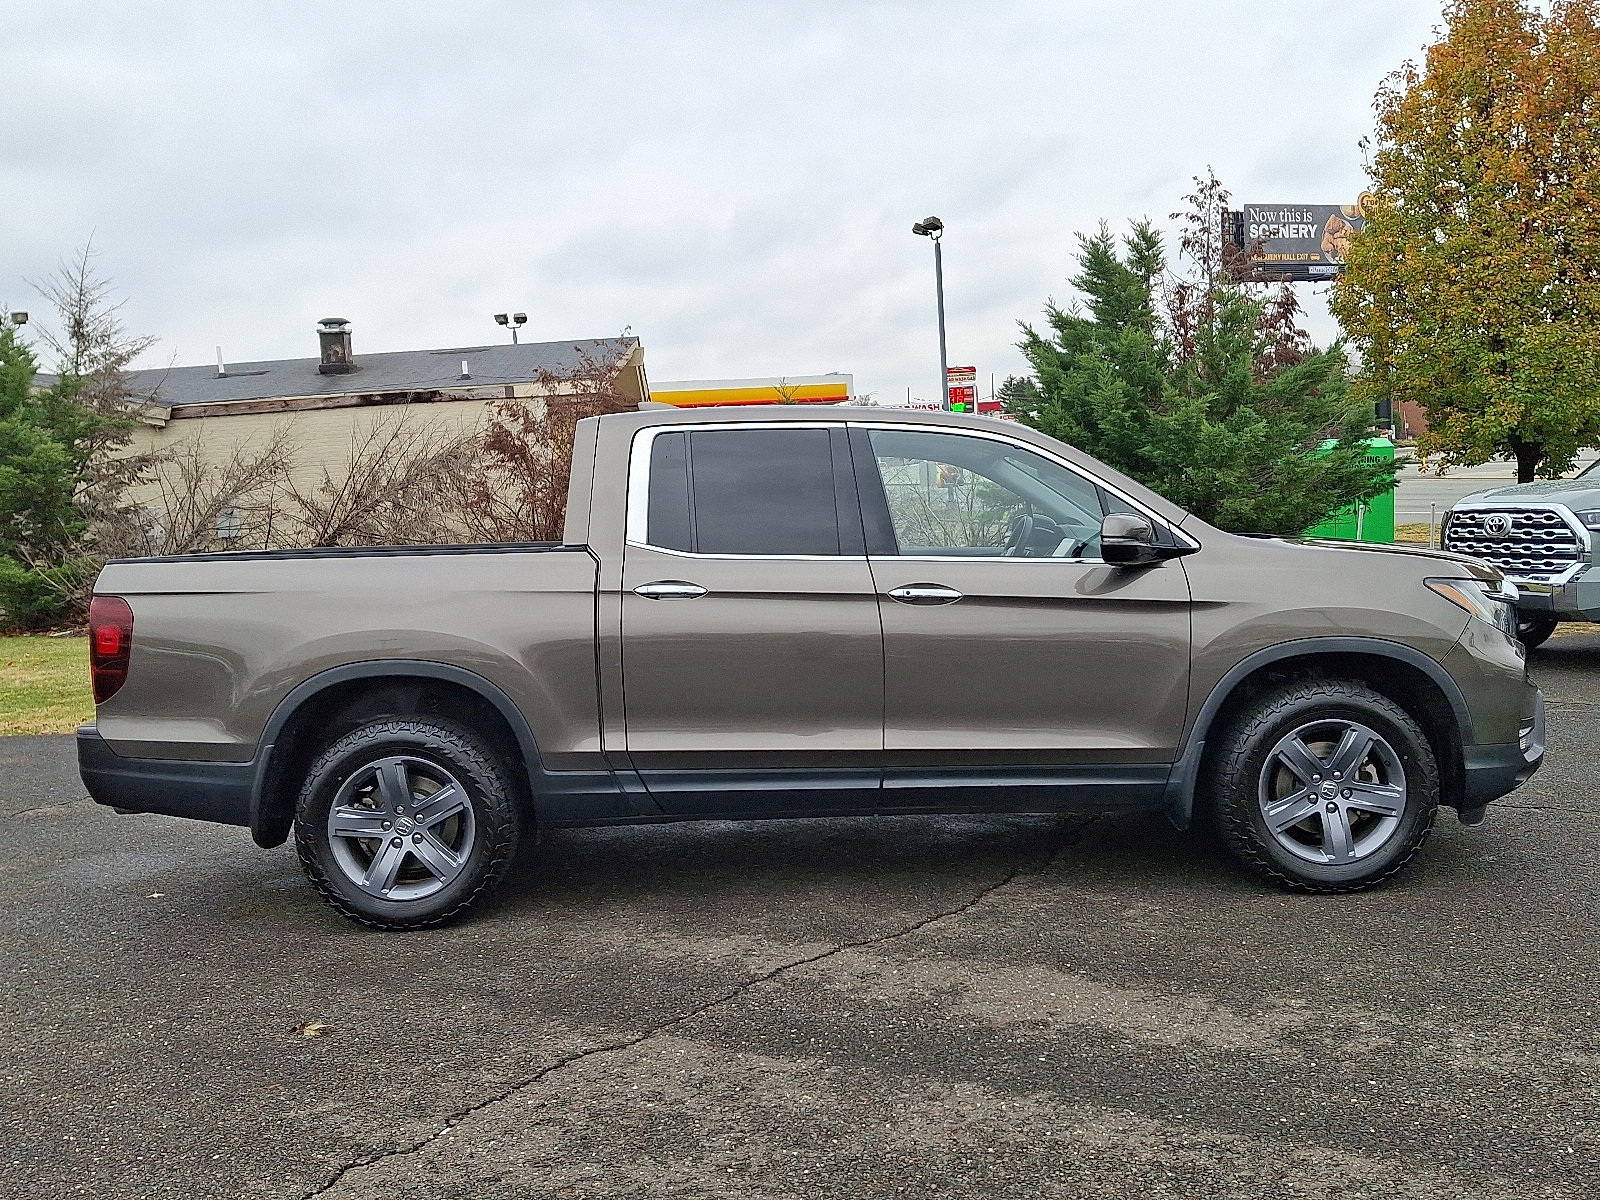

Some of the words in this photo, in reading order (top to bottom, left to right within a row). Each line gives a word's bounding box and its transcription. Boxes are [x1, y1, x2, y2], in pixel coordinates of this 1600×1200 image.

[1249, 208, 1277, 222] Now
[1279, 208, 1301, 222] this
[1303, 208, 1313, 222] is
[1249, 224, 1318, 239] SCENERY
